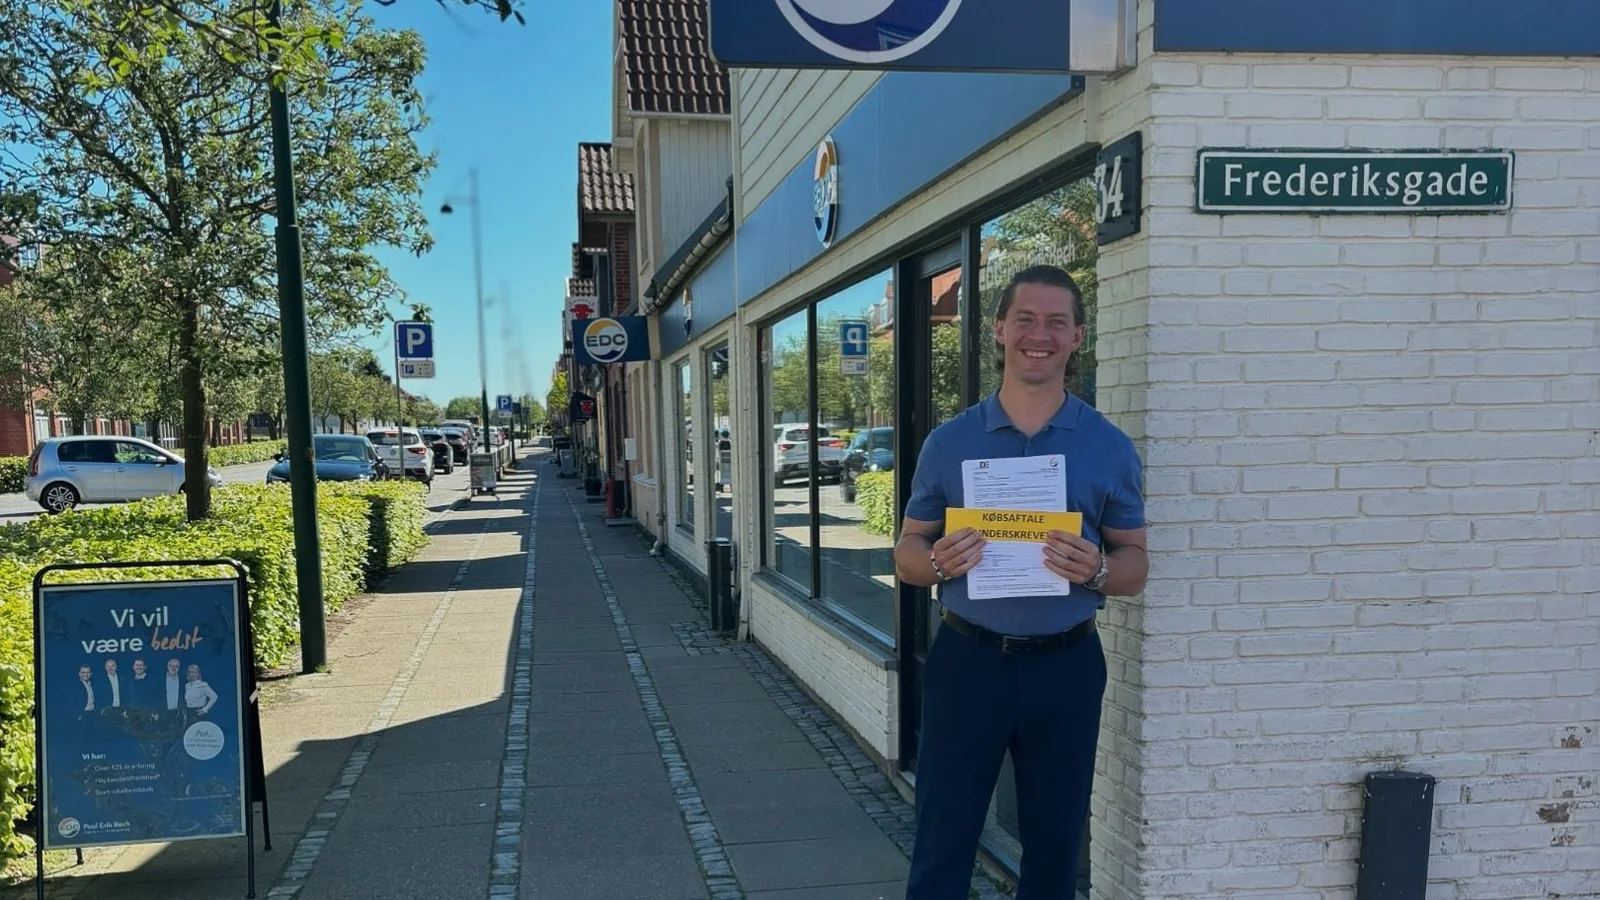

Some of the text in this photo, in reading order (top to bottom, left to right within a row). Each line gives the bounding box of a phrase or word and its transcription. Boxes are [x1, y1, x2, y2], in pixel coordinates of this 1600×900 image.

[1093, 155, 1124, 223] 34
[1224, 163, 1488, 205] Frederiksgade
[407, 328, 426, 354] P
[585, 333, 626, 347] EDC
[500, 398, 508, 408] P
[982, 513, 1045, 524] KØBSAFTALE
[974, 529, 1050, 540] NDERSKREVE
[110, 605, 169, 629] Vi vil
[81, 626, 203, 654] være bedst
